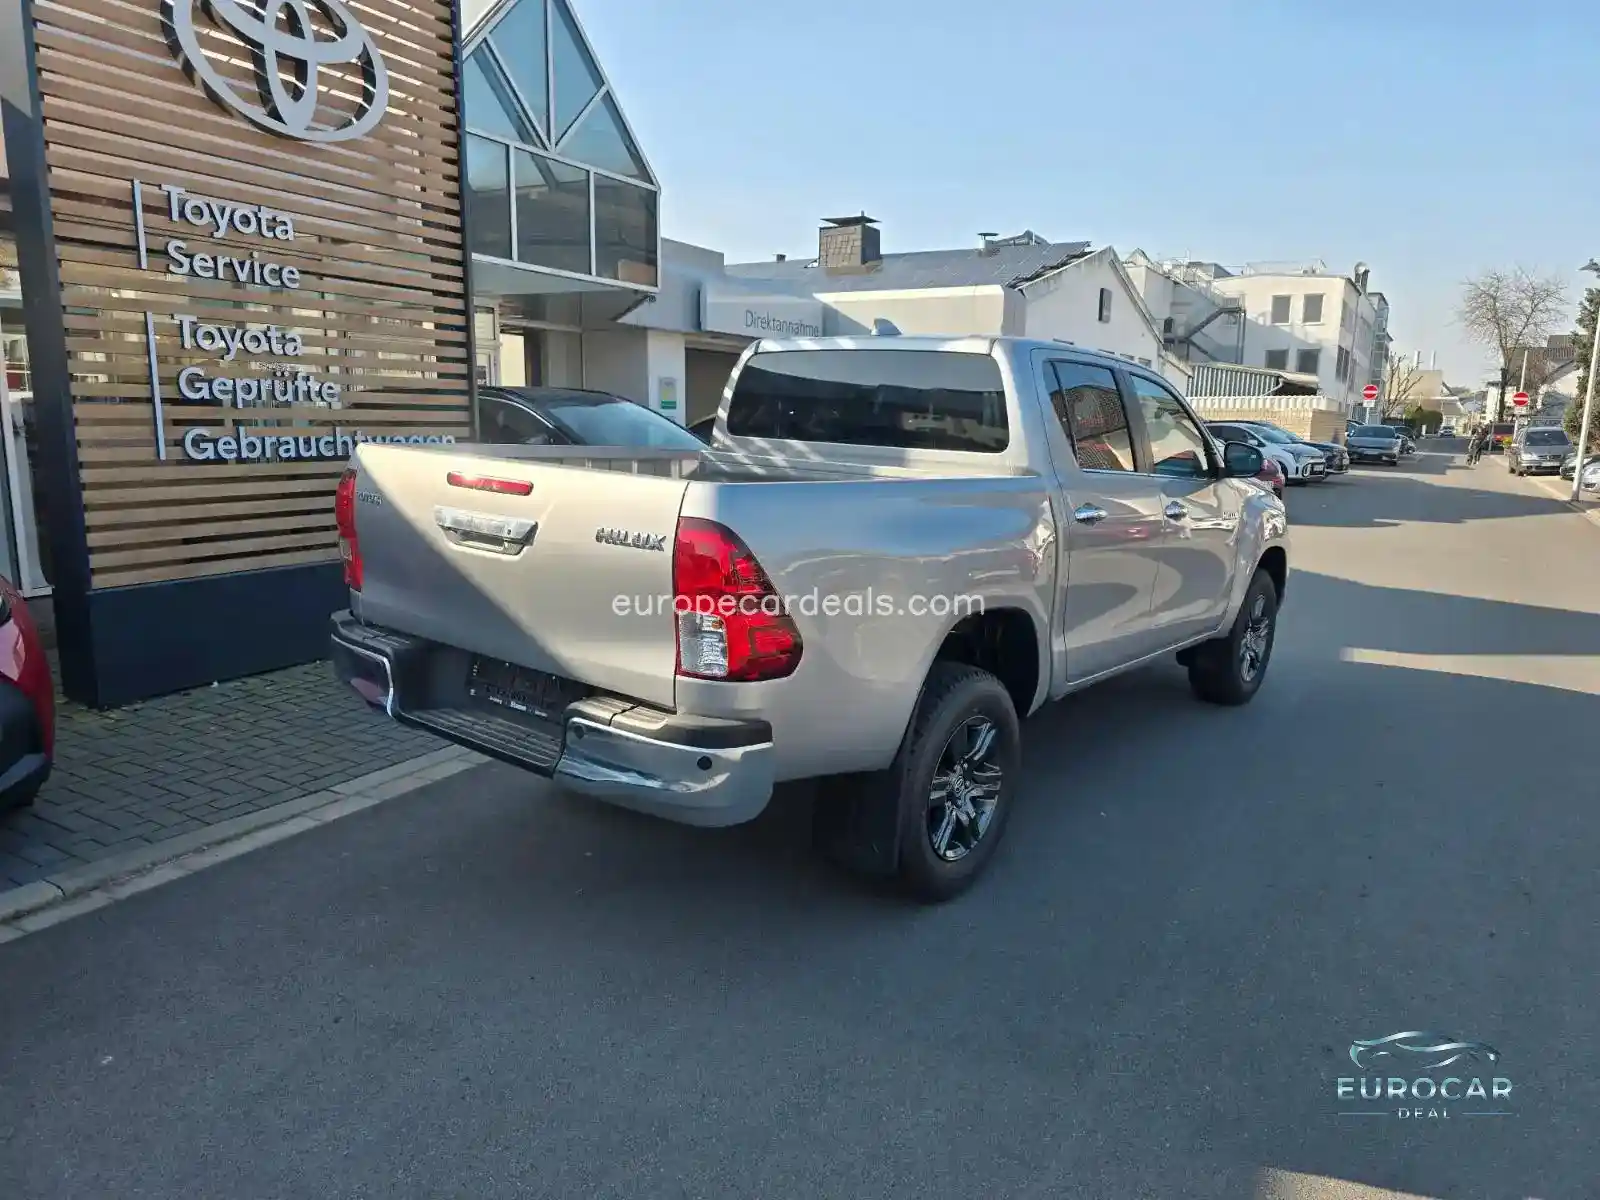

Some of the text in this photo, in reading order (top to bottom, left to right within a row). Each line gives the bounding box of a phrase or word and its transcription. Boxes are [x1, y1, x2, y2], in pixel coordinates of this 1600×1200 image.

[160, 184, 295, 241] Toyota
[166, 240, 300, 289] Service
[173, 314, 303, 361] Toyota
[744, 309, 820, 337] Direktannahme
[178, 366, 341, 409] Geprüfte
